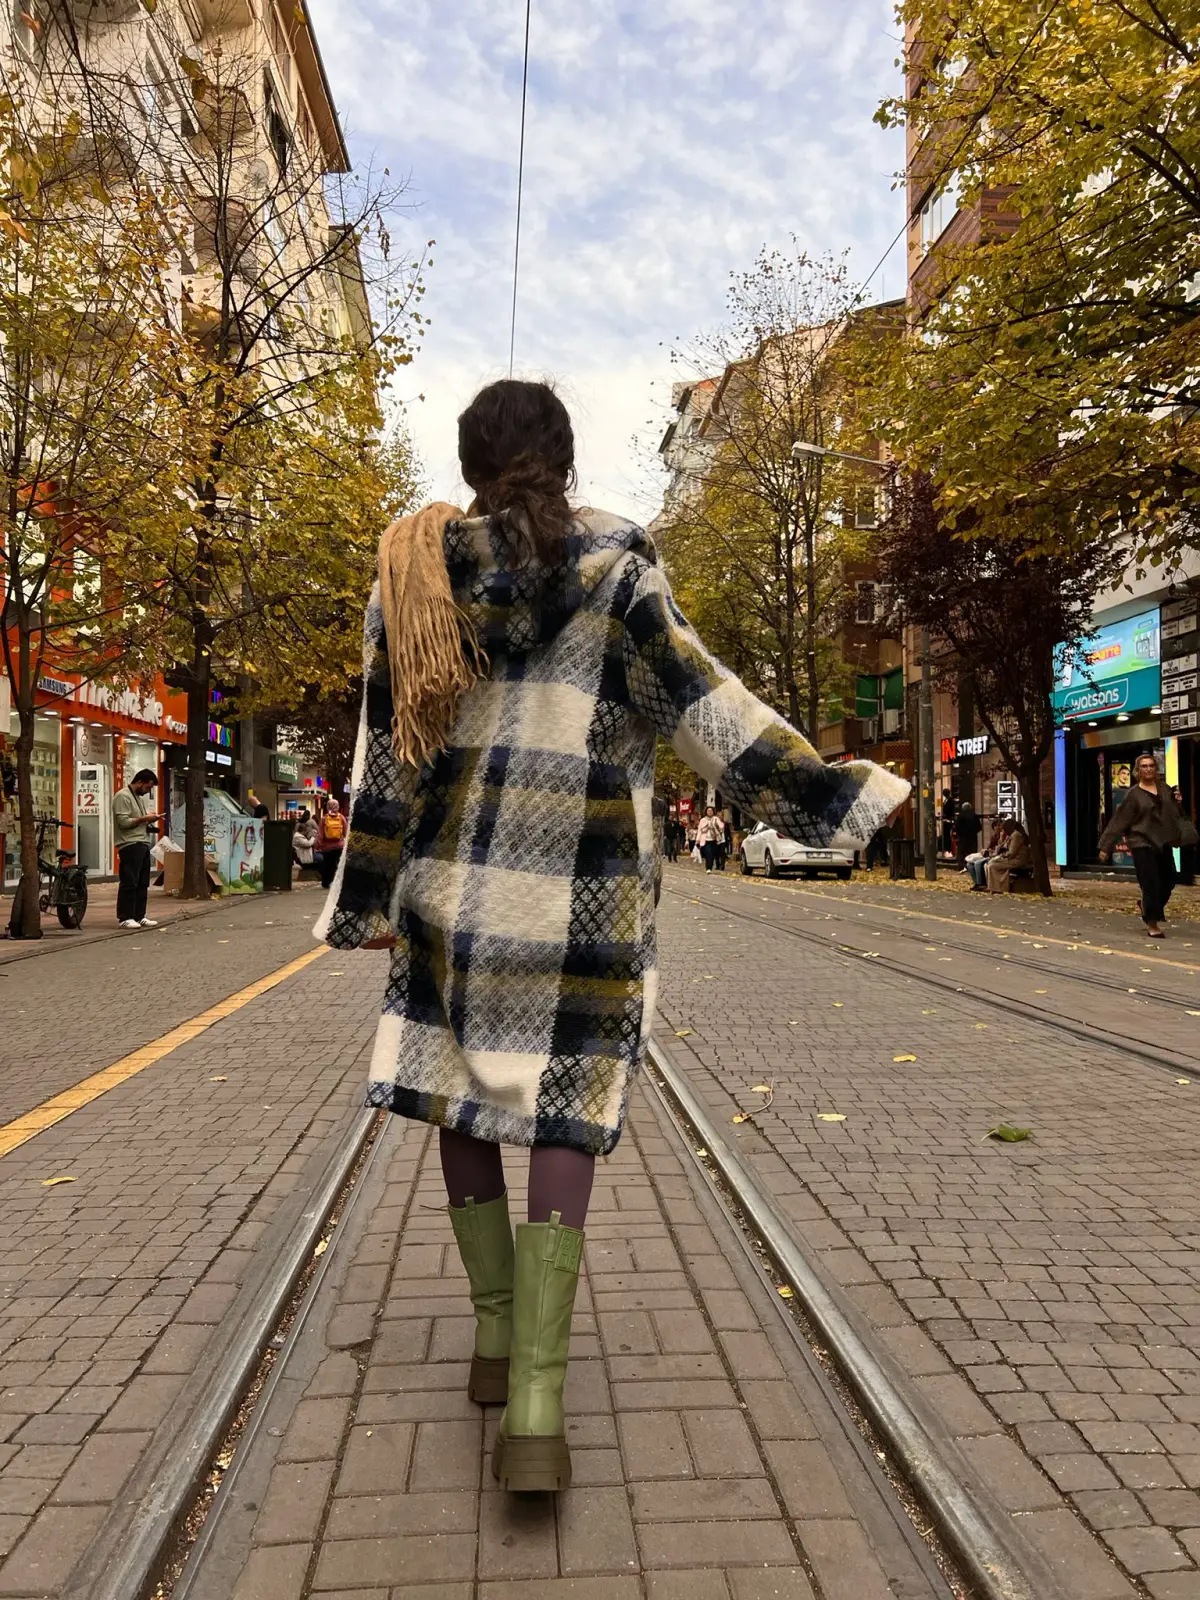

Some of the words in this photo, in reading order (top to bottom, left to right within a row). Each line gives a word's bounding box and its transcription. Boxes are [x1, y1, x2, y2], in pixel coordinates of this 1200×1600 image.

[38, 678, 67, 695] SAMSUNG
[1071, 688, 1120, 711] watsons
[941, 737, 956, 762] IN
[957, 735, 988, 757] STREET
